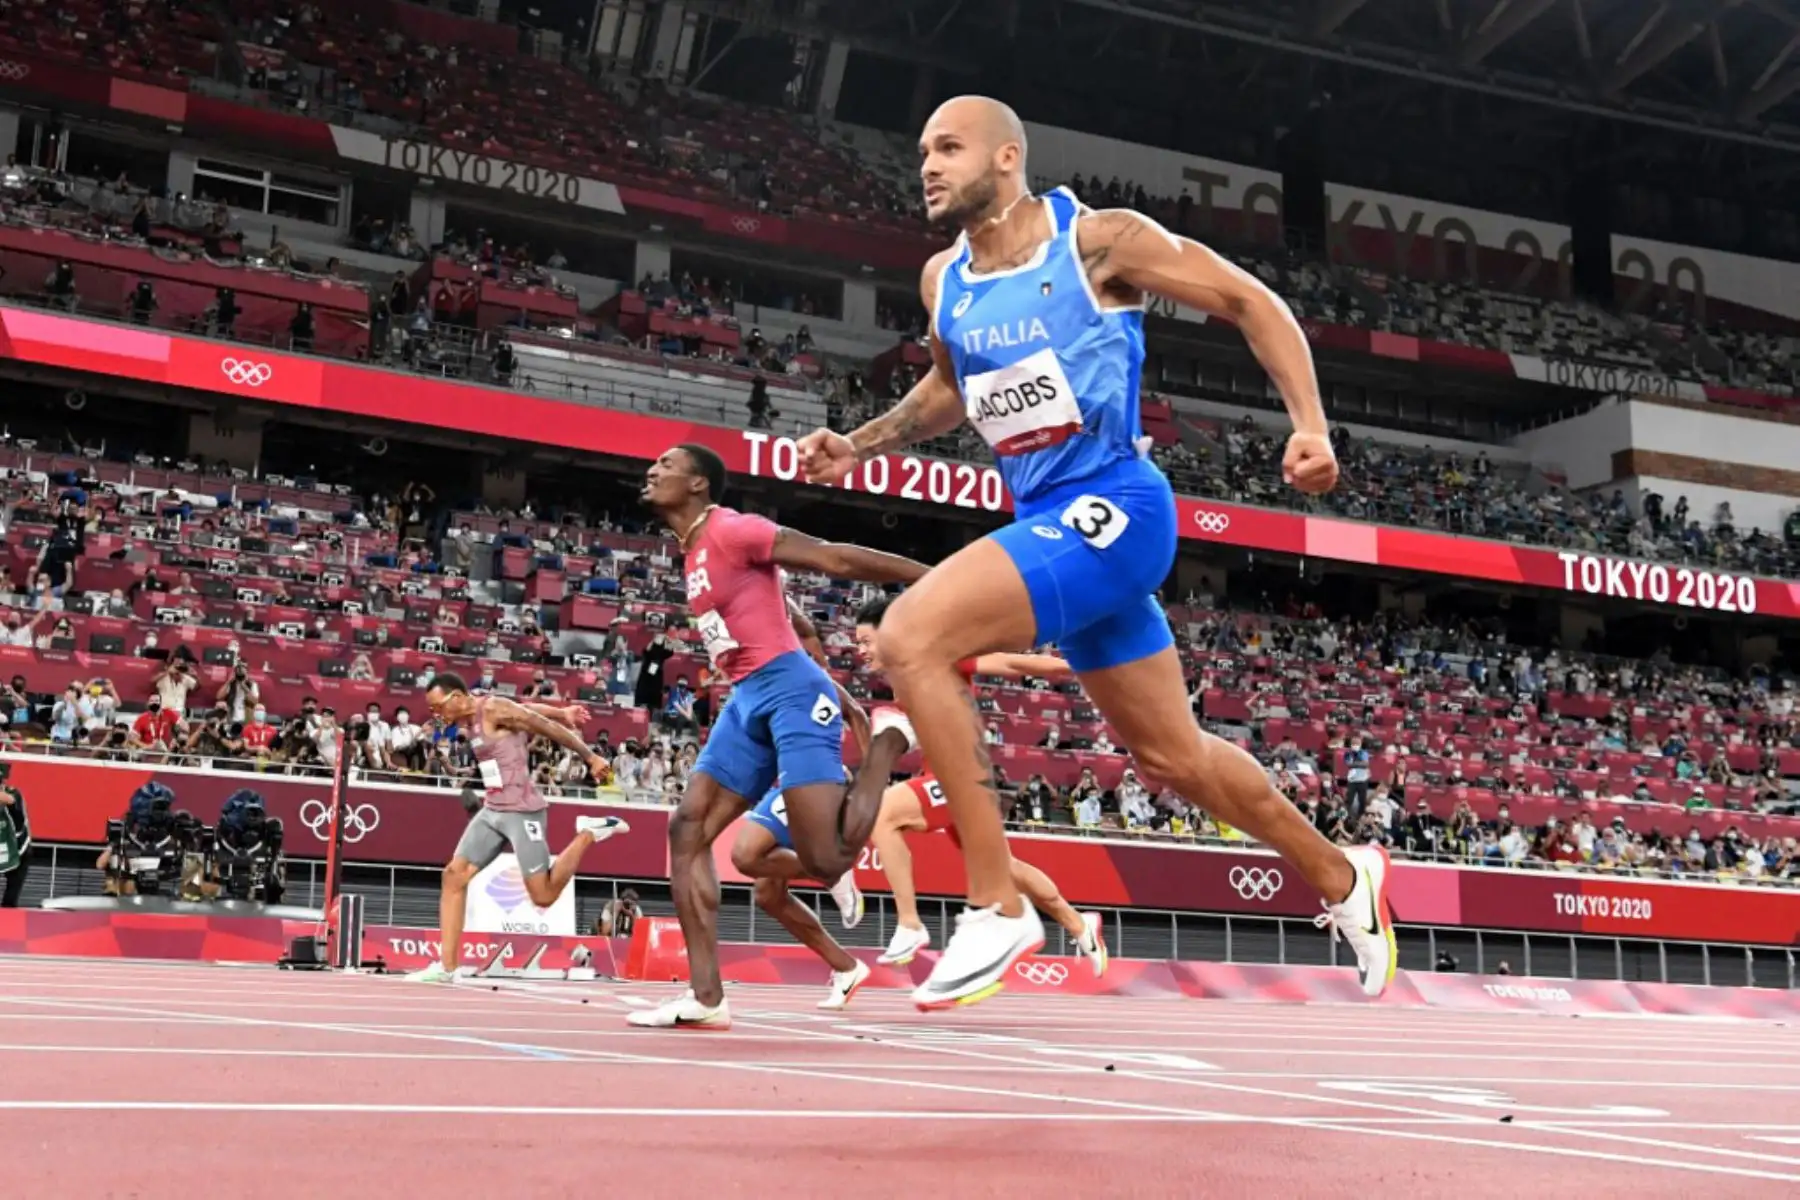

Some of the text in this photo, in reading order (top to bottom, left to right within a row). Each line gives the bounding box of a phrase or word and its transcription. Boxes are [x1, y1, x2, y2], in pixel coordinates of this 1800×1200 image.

[380, 134, 581, 204] TOKYO 2020
[962, 317, 1050, 354] ITALIA
[1541, 353, 1678, 397] TOKYO 2020
[975, 374, 1058, 422] JACOBS
[742, 431, 1003, 512] TOO 2020
[1072, 501, 1113, 539] 3
[1558, 551, 1757, 614] TOKYO 2020
[1553, 892, 1653, 920] TOKYO 2020
[389, 938, 443, 958] TOKY
[501, 921, 549, 934] WORLD
